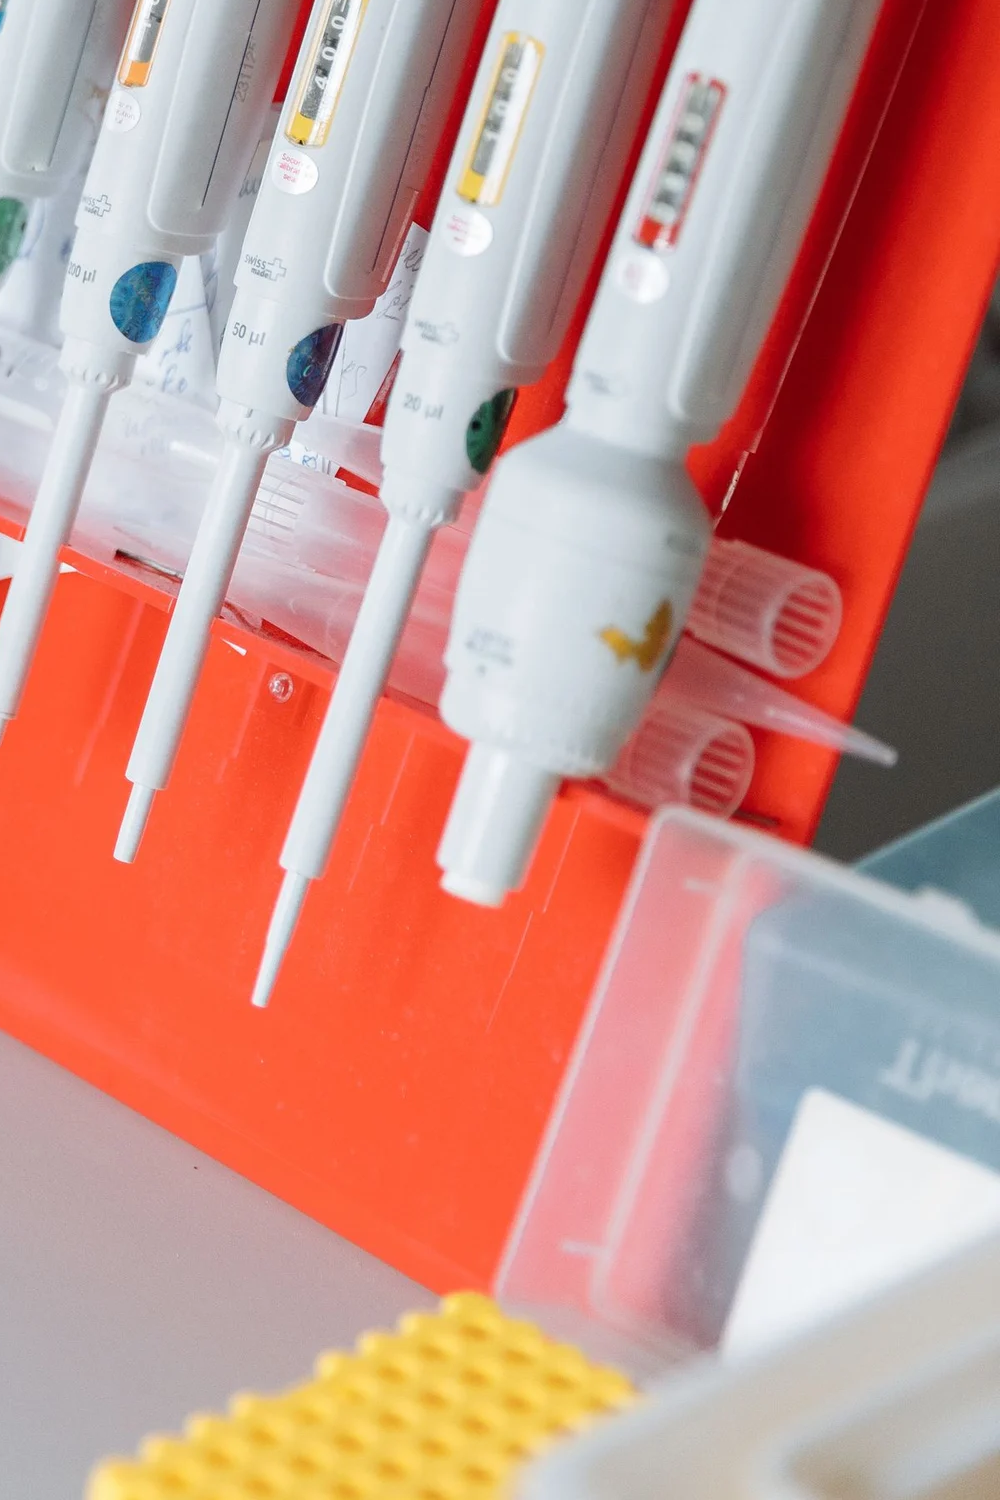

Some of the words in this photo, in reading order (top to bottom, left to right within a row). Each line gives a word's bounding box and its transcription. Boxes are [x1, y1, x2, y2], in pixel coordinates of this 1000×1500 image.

[244, 253, 267, 271] swiss
[232, 320, 248, 340] 50
[248, 330, 267, 347] µl
